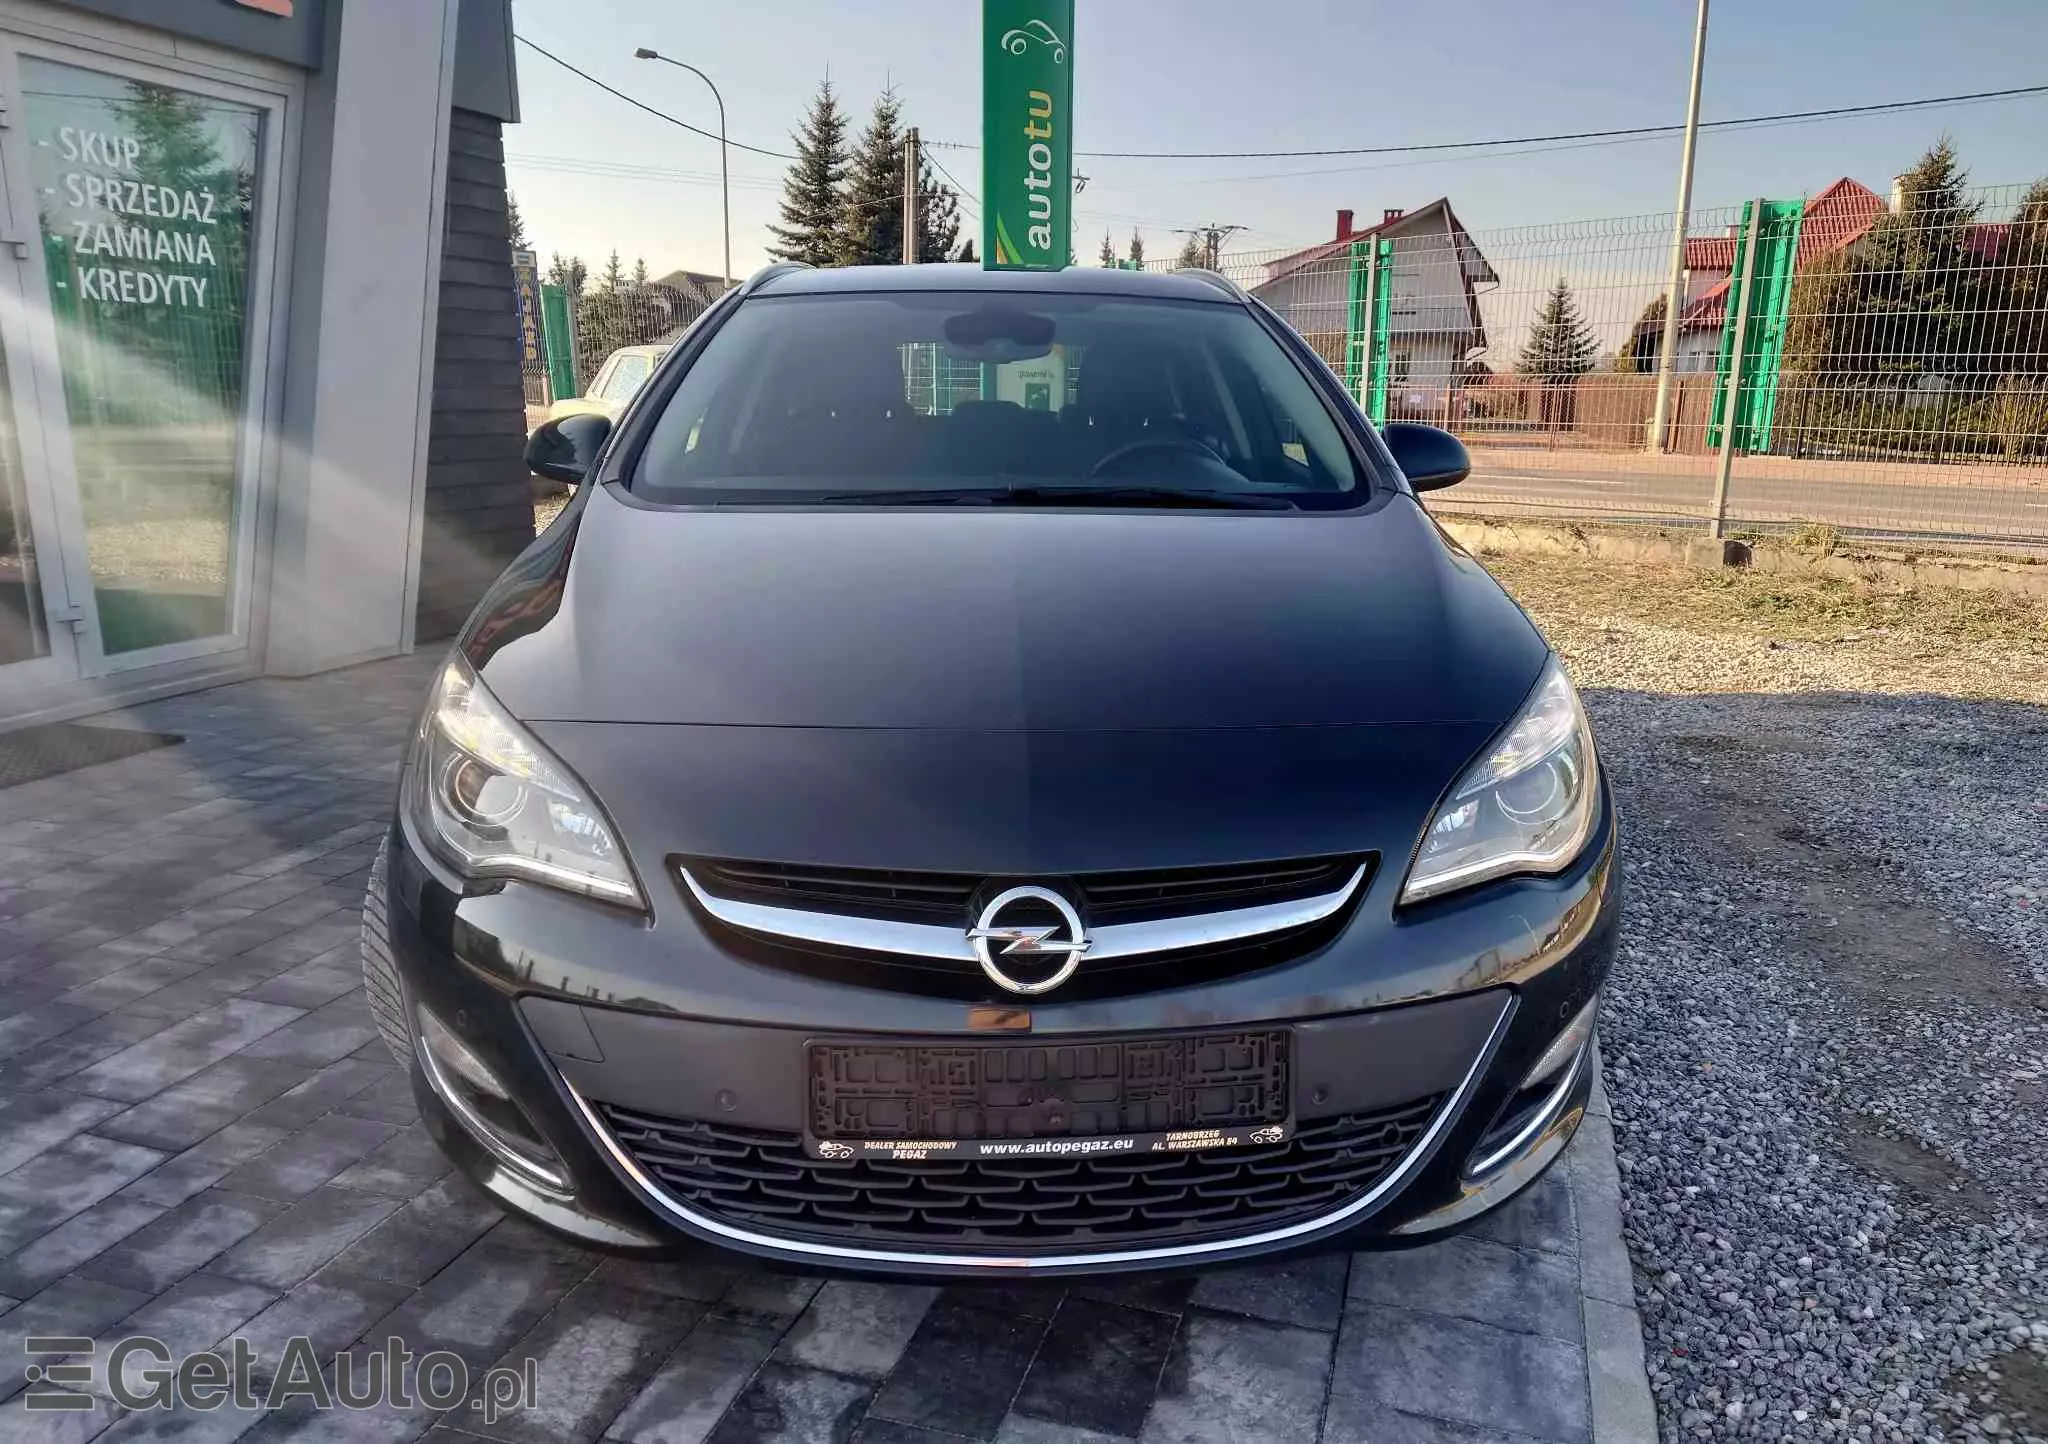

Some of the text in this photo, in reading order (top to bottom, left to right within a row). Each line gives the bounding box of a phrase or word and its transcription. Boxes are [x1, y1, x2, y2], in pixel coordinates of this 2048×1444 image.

[60, 126, 140, 169] SKUP
[1024, 90, 1052, 250] autotu
[66, 173, 217, 225] SPRZEDAŻ
[72, 220, 217, 266] ZAMIANA
[77, 266, 207, 308] KREDYTY
[864, 1141, 957, 1150] DEALER SAMOCHODOWY
[980, 1139, 1133, 1154] www.autopegaz.eu
[1166, 1130, 1220, 1141] TARNOBRZEG
[1168, 1138, 1225, 1150] WARSZAWSKA
[892, 1150, 927, 1159] PEGAZ
